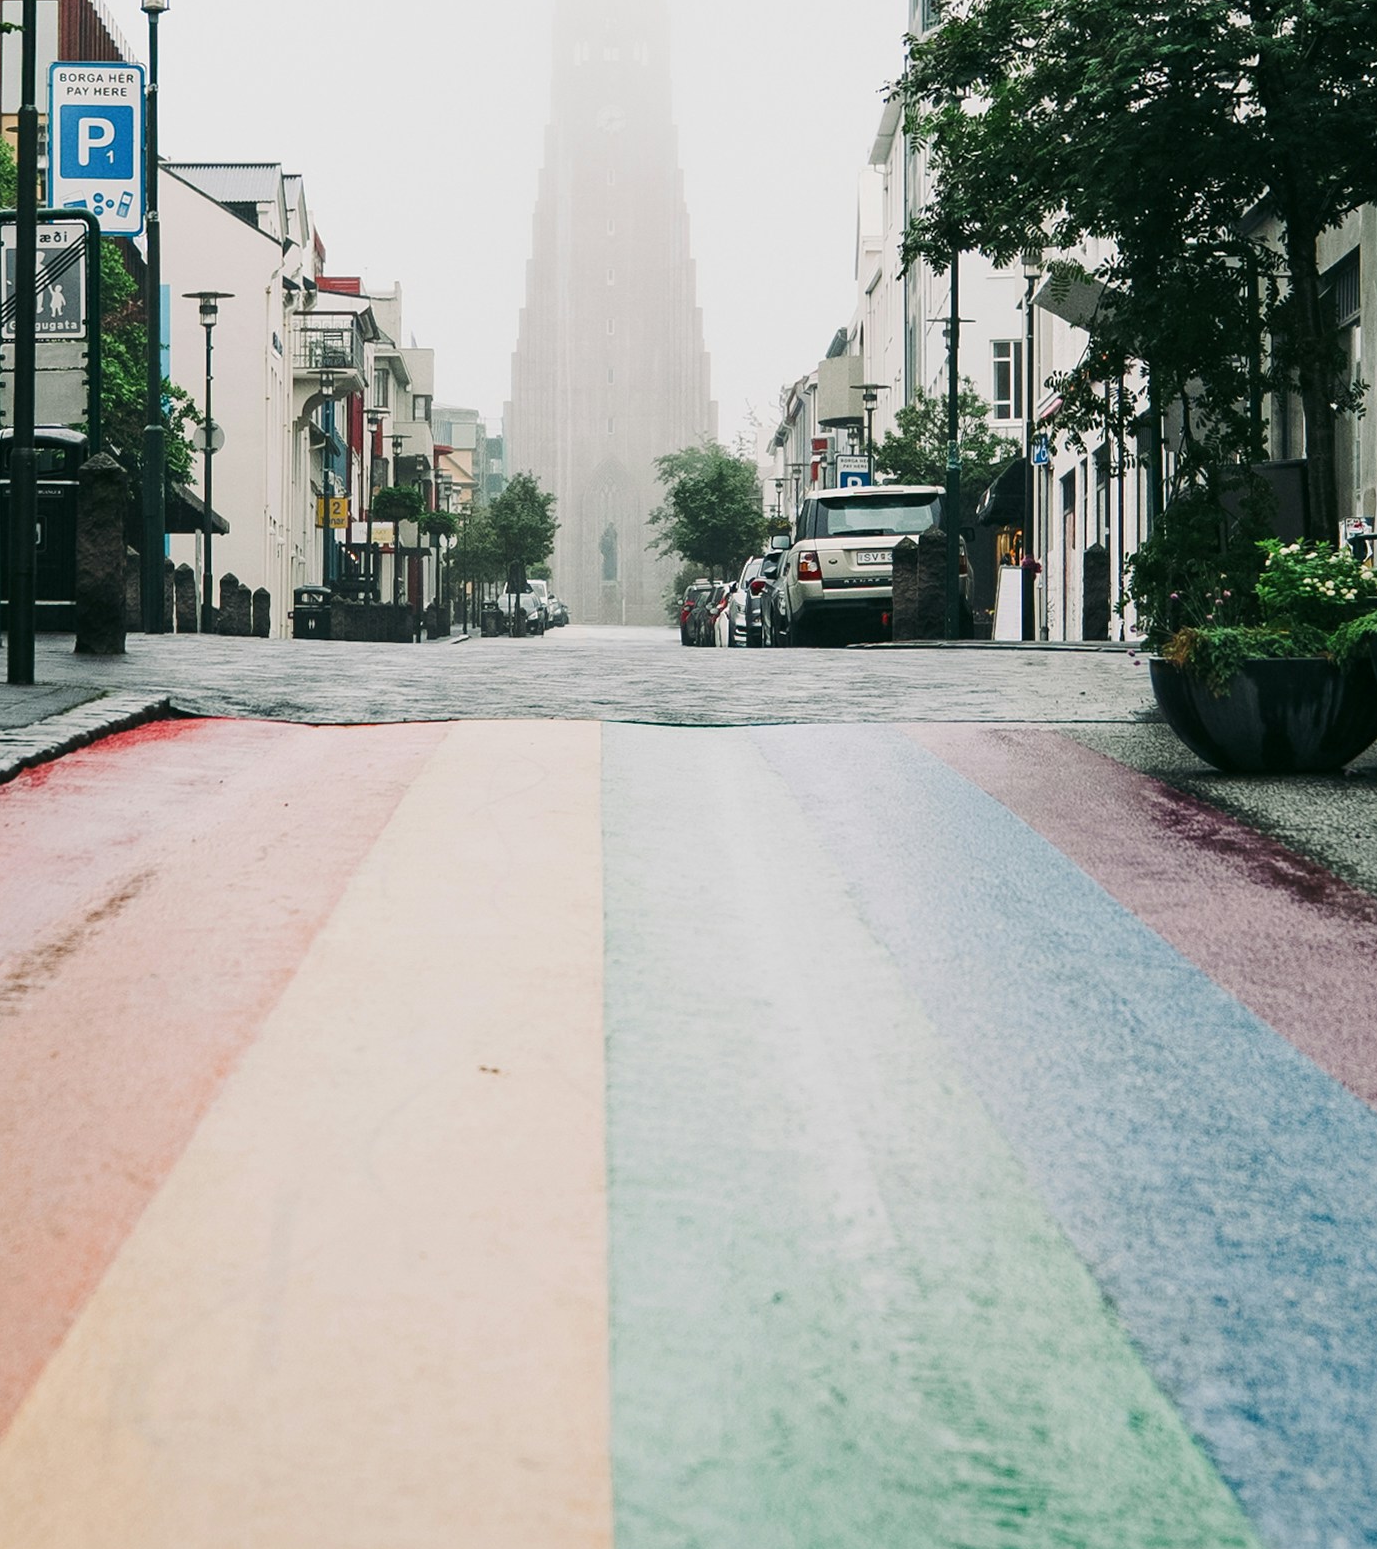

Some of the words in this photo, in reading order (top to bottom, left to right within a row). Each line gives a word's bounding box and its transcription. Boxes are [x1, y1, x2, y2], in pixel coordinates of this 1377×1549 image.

[59, 72, 104, 84] BORGA
[108, 72, 135, 84] HÉR
[66, 86, 90, 97] PAY
[93, 87, 128, 97] HERE
[9, 320, 78, 332] Ggugata
